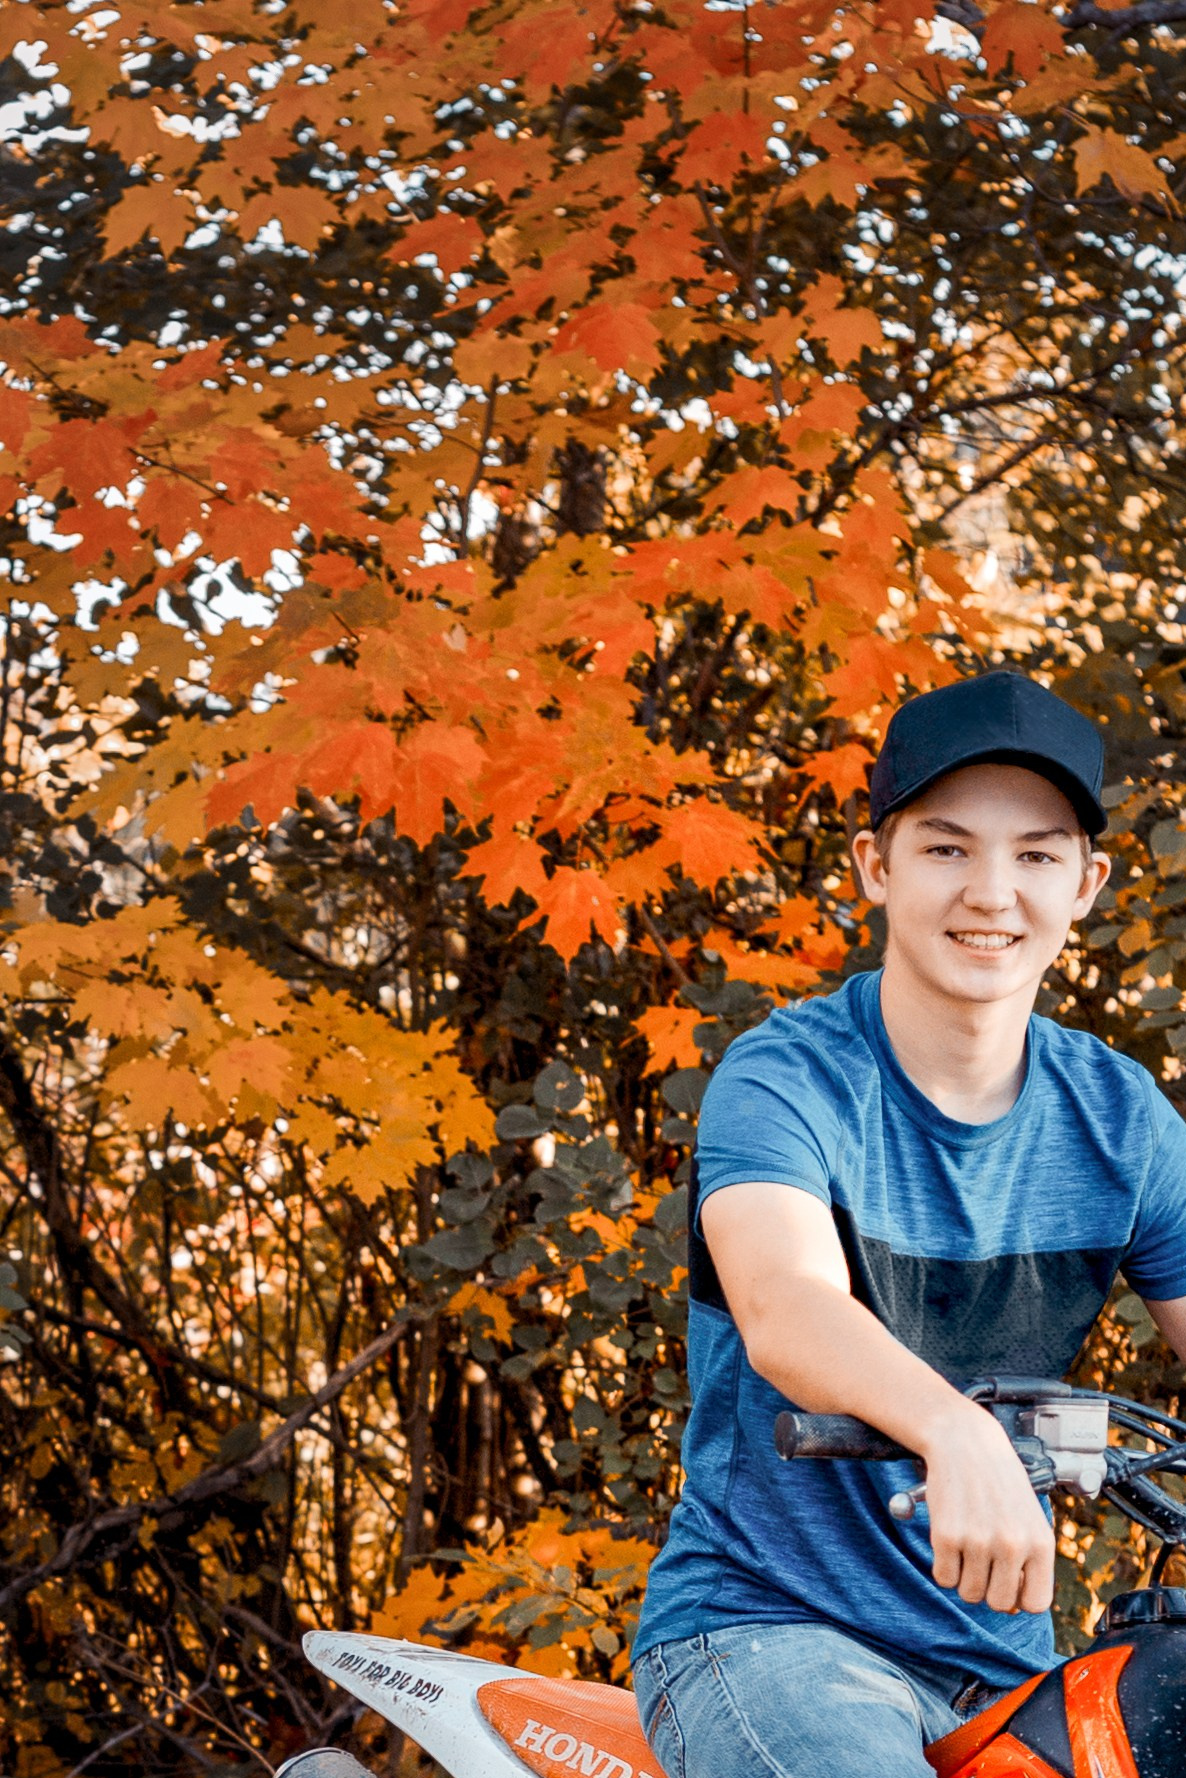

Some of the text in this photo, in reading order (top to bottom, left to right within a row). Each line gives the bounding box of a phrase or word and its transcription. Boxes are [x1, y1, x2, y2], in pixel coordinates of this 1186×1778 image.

[332, 1652, 444, 1702] TOYS FOR BIG BOYS
